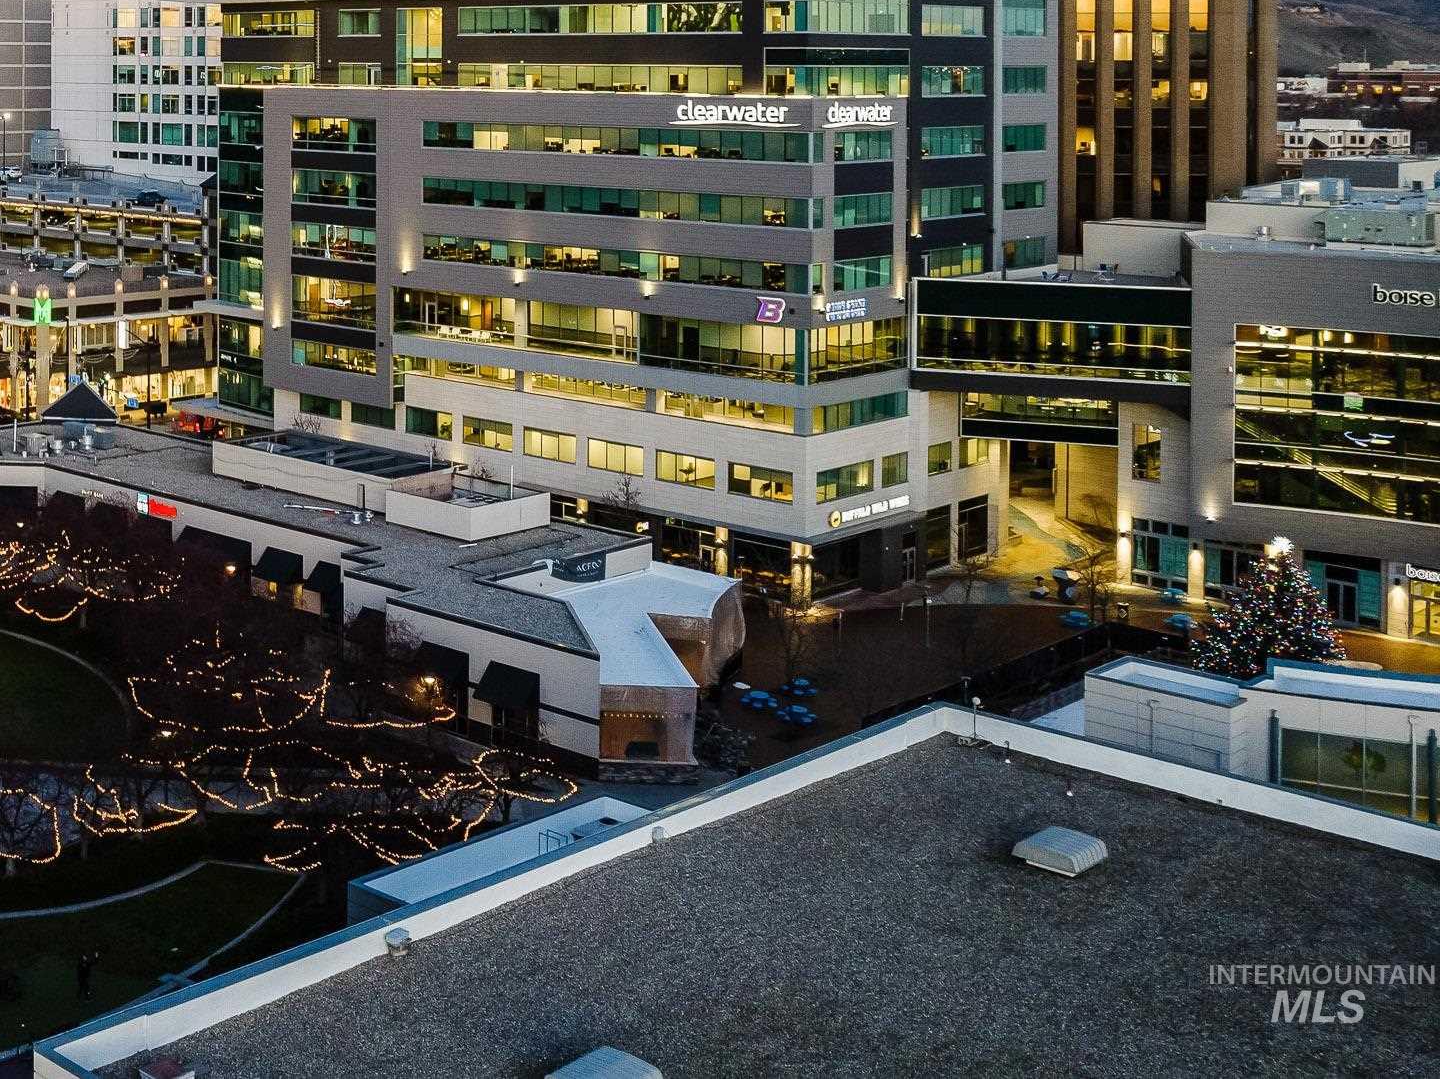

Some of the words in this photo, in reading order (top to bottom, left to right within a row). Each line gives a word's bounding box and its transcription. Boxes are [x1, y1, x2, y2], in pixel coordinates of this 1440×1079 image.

[676, 100, 789, 123] clearwater
[827, 101, 893, 123] clearwater
[1372, 283, 1436, 308] boise
